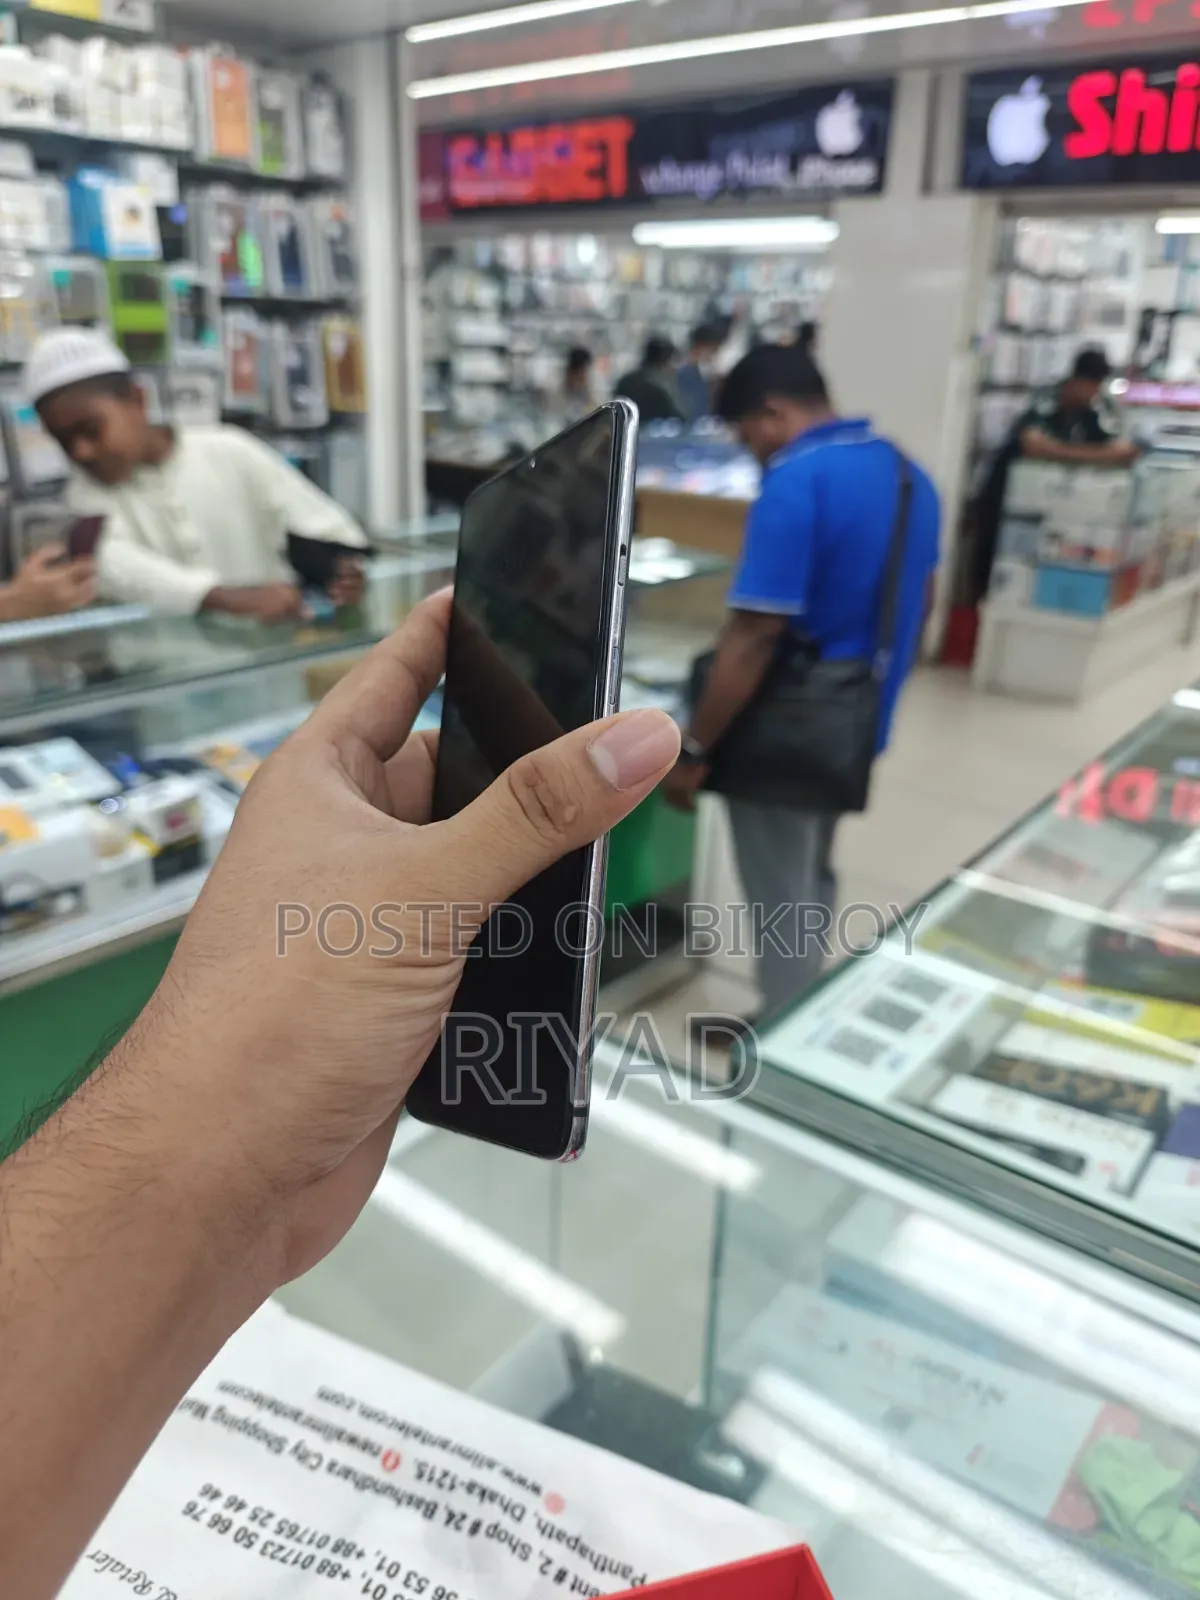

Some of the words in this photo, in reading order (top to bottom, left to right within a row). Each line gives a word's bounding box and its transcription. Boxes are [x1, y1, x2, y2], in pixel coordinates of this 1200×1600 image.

[1062, 62, 1200, 159] Shi
[210, 1405, 289, 1455] Shopping
[288, 1438, 324, 1471] City
[198, 1482, 223, 1501] 46
[326, 1457, 439, 1521] Bashundhara
[181, 1500, 207, 1523] 76
[222, 1494, 248, 1514] 46
[248, 1505, 275, 1528] 25
[207, 1512, 234, 1535] 66
[274, 1517, 331, 1550] 01765
[233, 1526, 260, 1550] 50
[330, 1537, 366, 1560] +88
[484, 1523, 533, 1563] Shop
[532, 1511, 648, 1589] Panthapath,
[259, 1540, 316, 1570] 01723
[374, 1550, 401, 1579] 01,
[538, 1550, 554, 1576] 2,
[87, 1549, 155, 1596] Retaler
[316, 1558, 352, 1581] +88
[402, 1570, 430, 1595] 53
